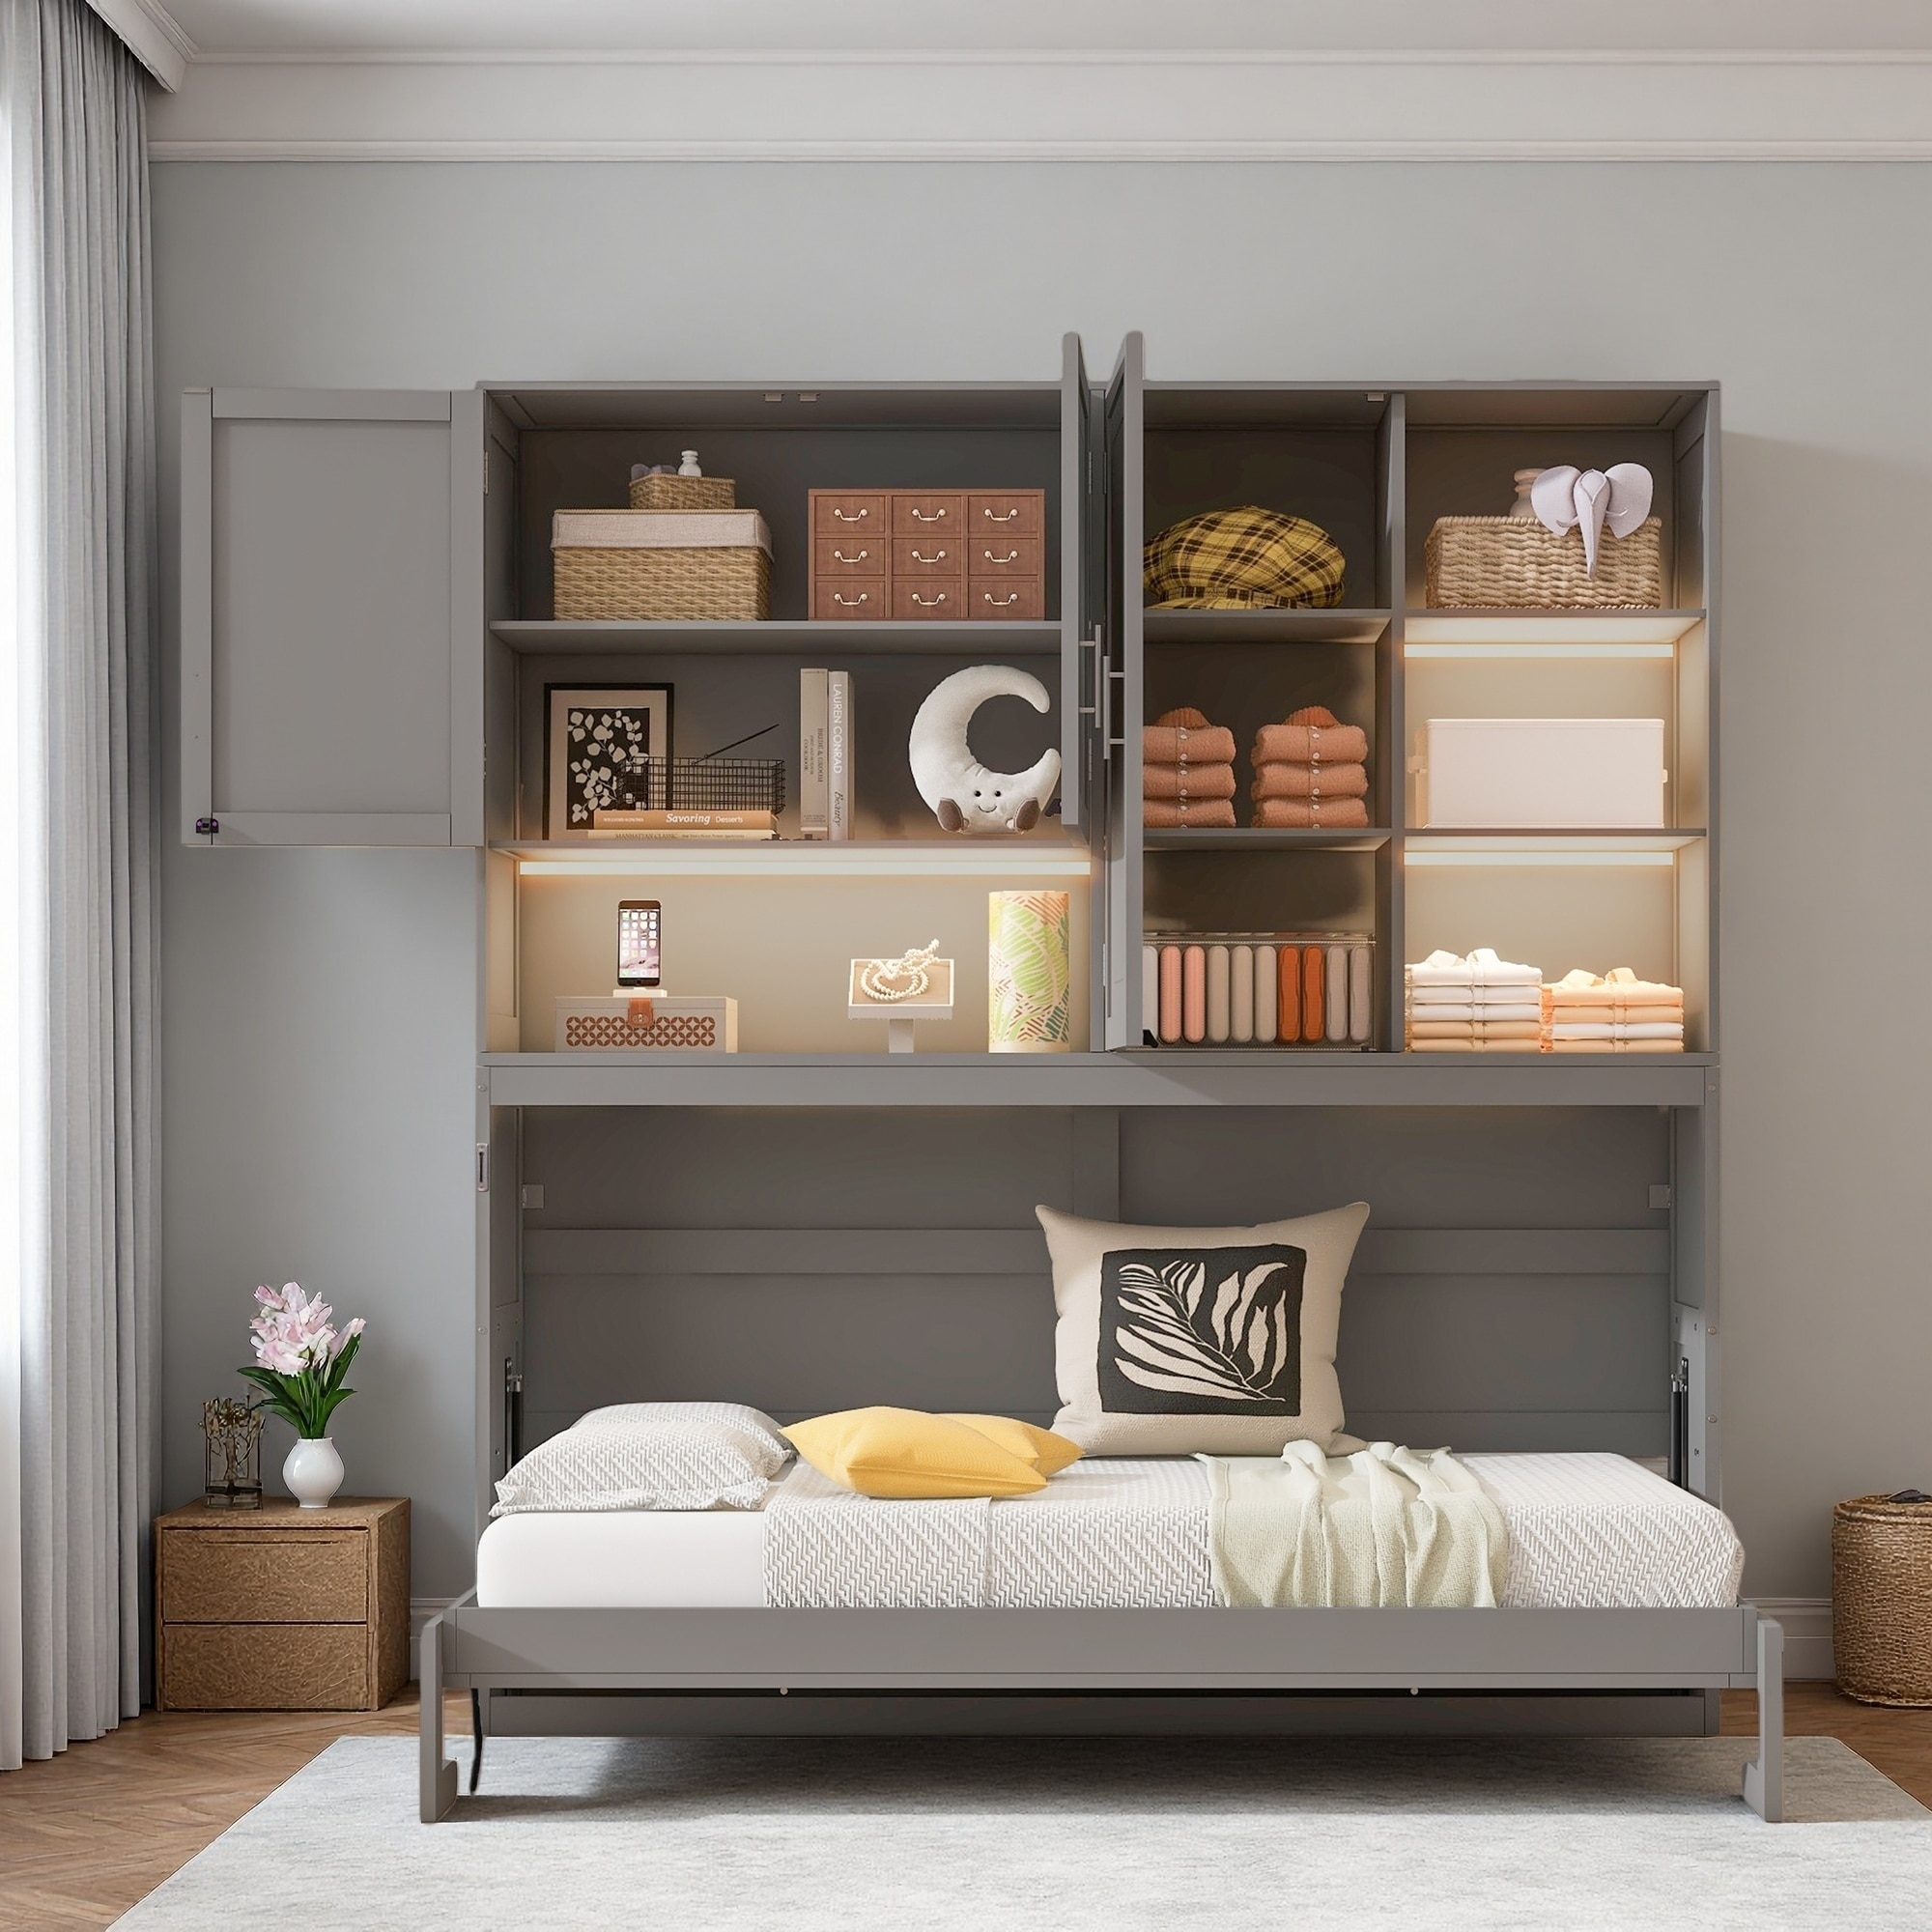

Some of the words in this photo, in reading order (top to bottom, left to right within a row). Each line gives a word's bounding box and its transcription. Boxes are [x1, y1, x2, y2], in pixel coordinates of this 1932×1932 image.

[833, 684, 842, 724] LAUREN
[833, 725, 842, 774] CONRAD
[666, 813, 711, 826] Savoring
[832, 791, 843, 827] Beauty
